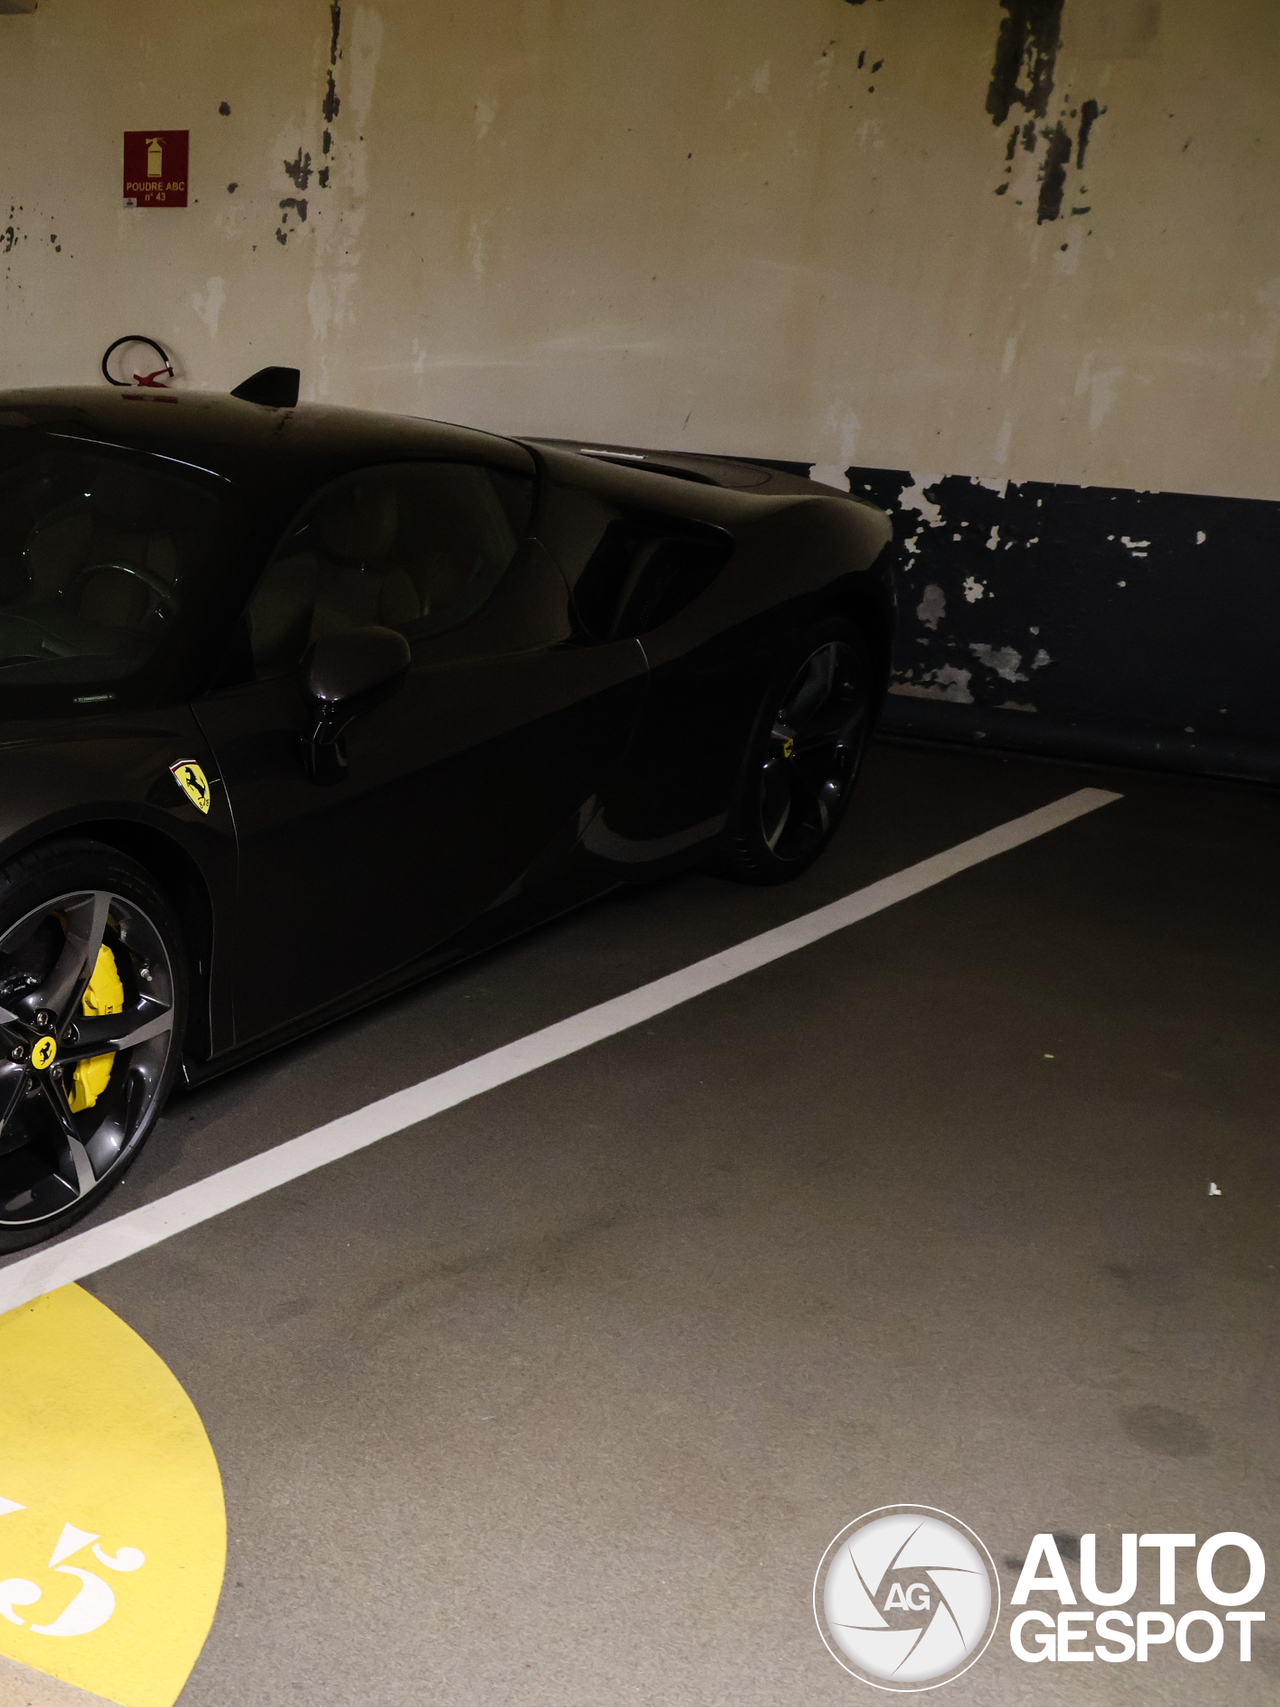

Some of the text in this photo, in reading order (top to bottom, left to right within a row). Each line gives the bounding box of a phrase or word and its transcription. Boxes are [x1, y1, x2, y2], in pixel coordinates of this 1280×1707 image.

[126, 181, 185, 191] POUDRE ABC
[155, 192, 166, 201] 43
